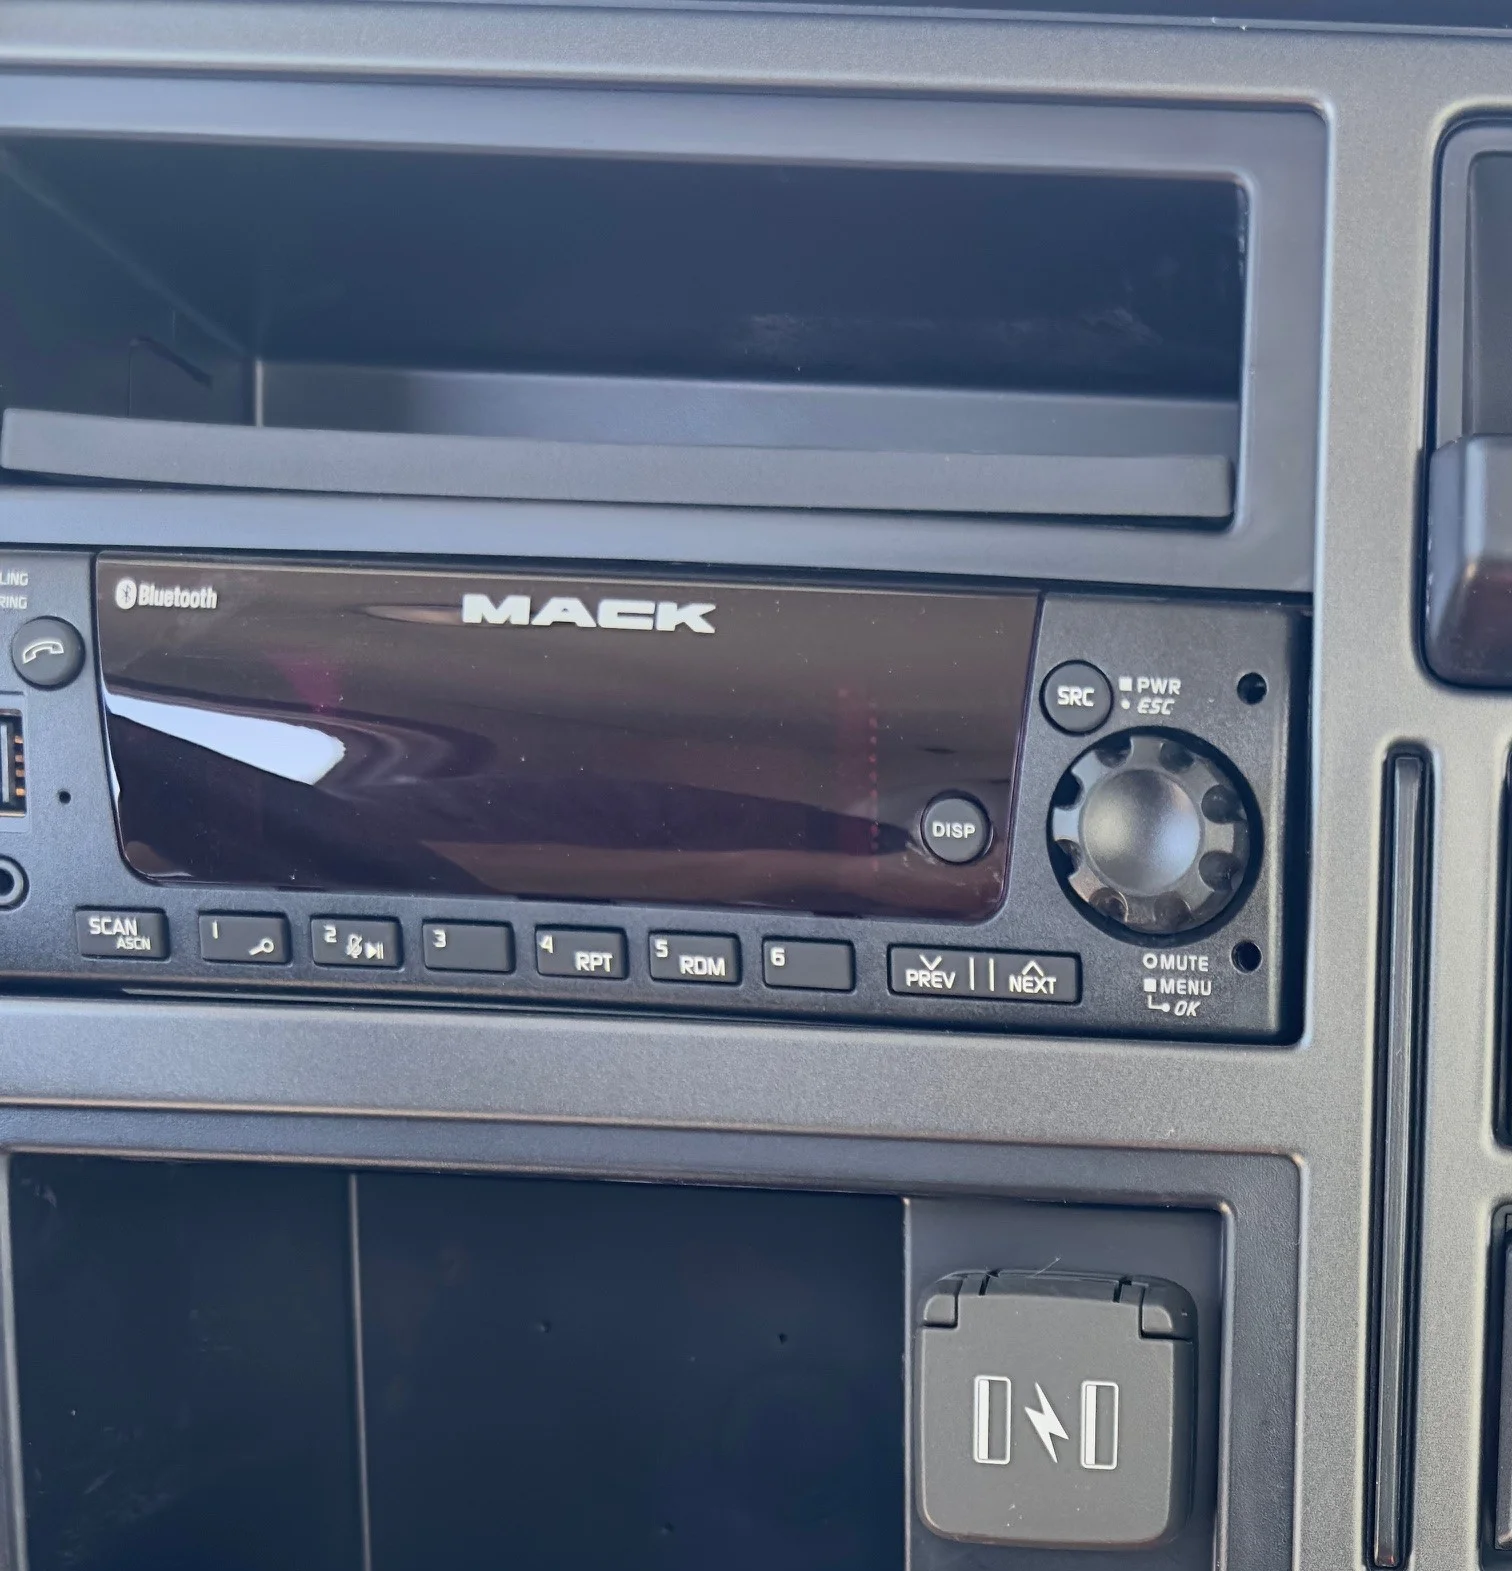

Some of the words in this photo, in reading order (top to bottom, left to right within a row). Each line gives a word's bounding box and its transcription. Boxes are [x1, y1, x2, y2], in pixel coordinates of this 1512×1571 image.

[0, 571, 29, 586] LING
[138, 582, 218, 609] Bluetooth
[461, 593, 716, 633] MACK
[1136, 677, 1181, 695] PWR
[1056, 685, 1095, 708] SRC
[1136, 698, 1175, 716] ESC
[932, 820, 976, 838] DISP
[88, 917, 138, 935] SCAN
[210, 922, 219, 940] 1
[322, 926, 337, 943] 2
[116, 935, 151, 951] ASCN
[432, 931, 447, 948] 3
[539, 935, 554, 952] 4
[655, 940, 668, 958] 5
[770, 948, 785, 967] 6
[574, 952, 613, 972] RPT
[679, 955, 726, 977] RDM
[1160, 954, 1209, 972] MUTE
[905, 969, 956, 990] PREV
[1008, 974, 1056, 995] NEXT
[1160, 978, 1212, 996] MENU
[1173, 1000, 1200, 1017] OK
